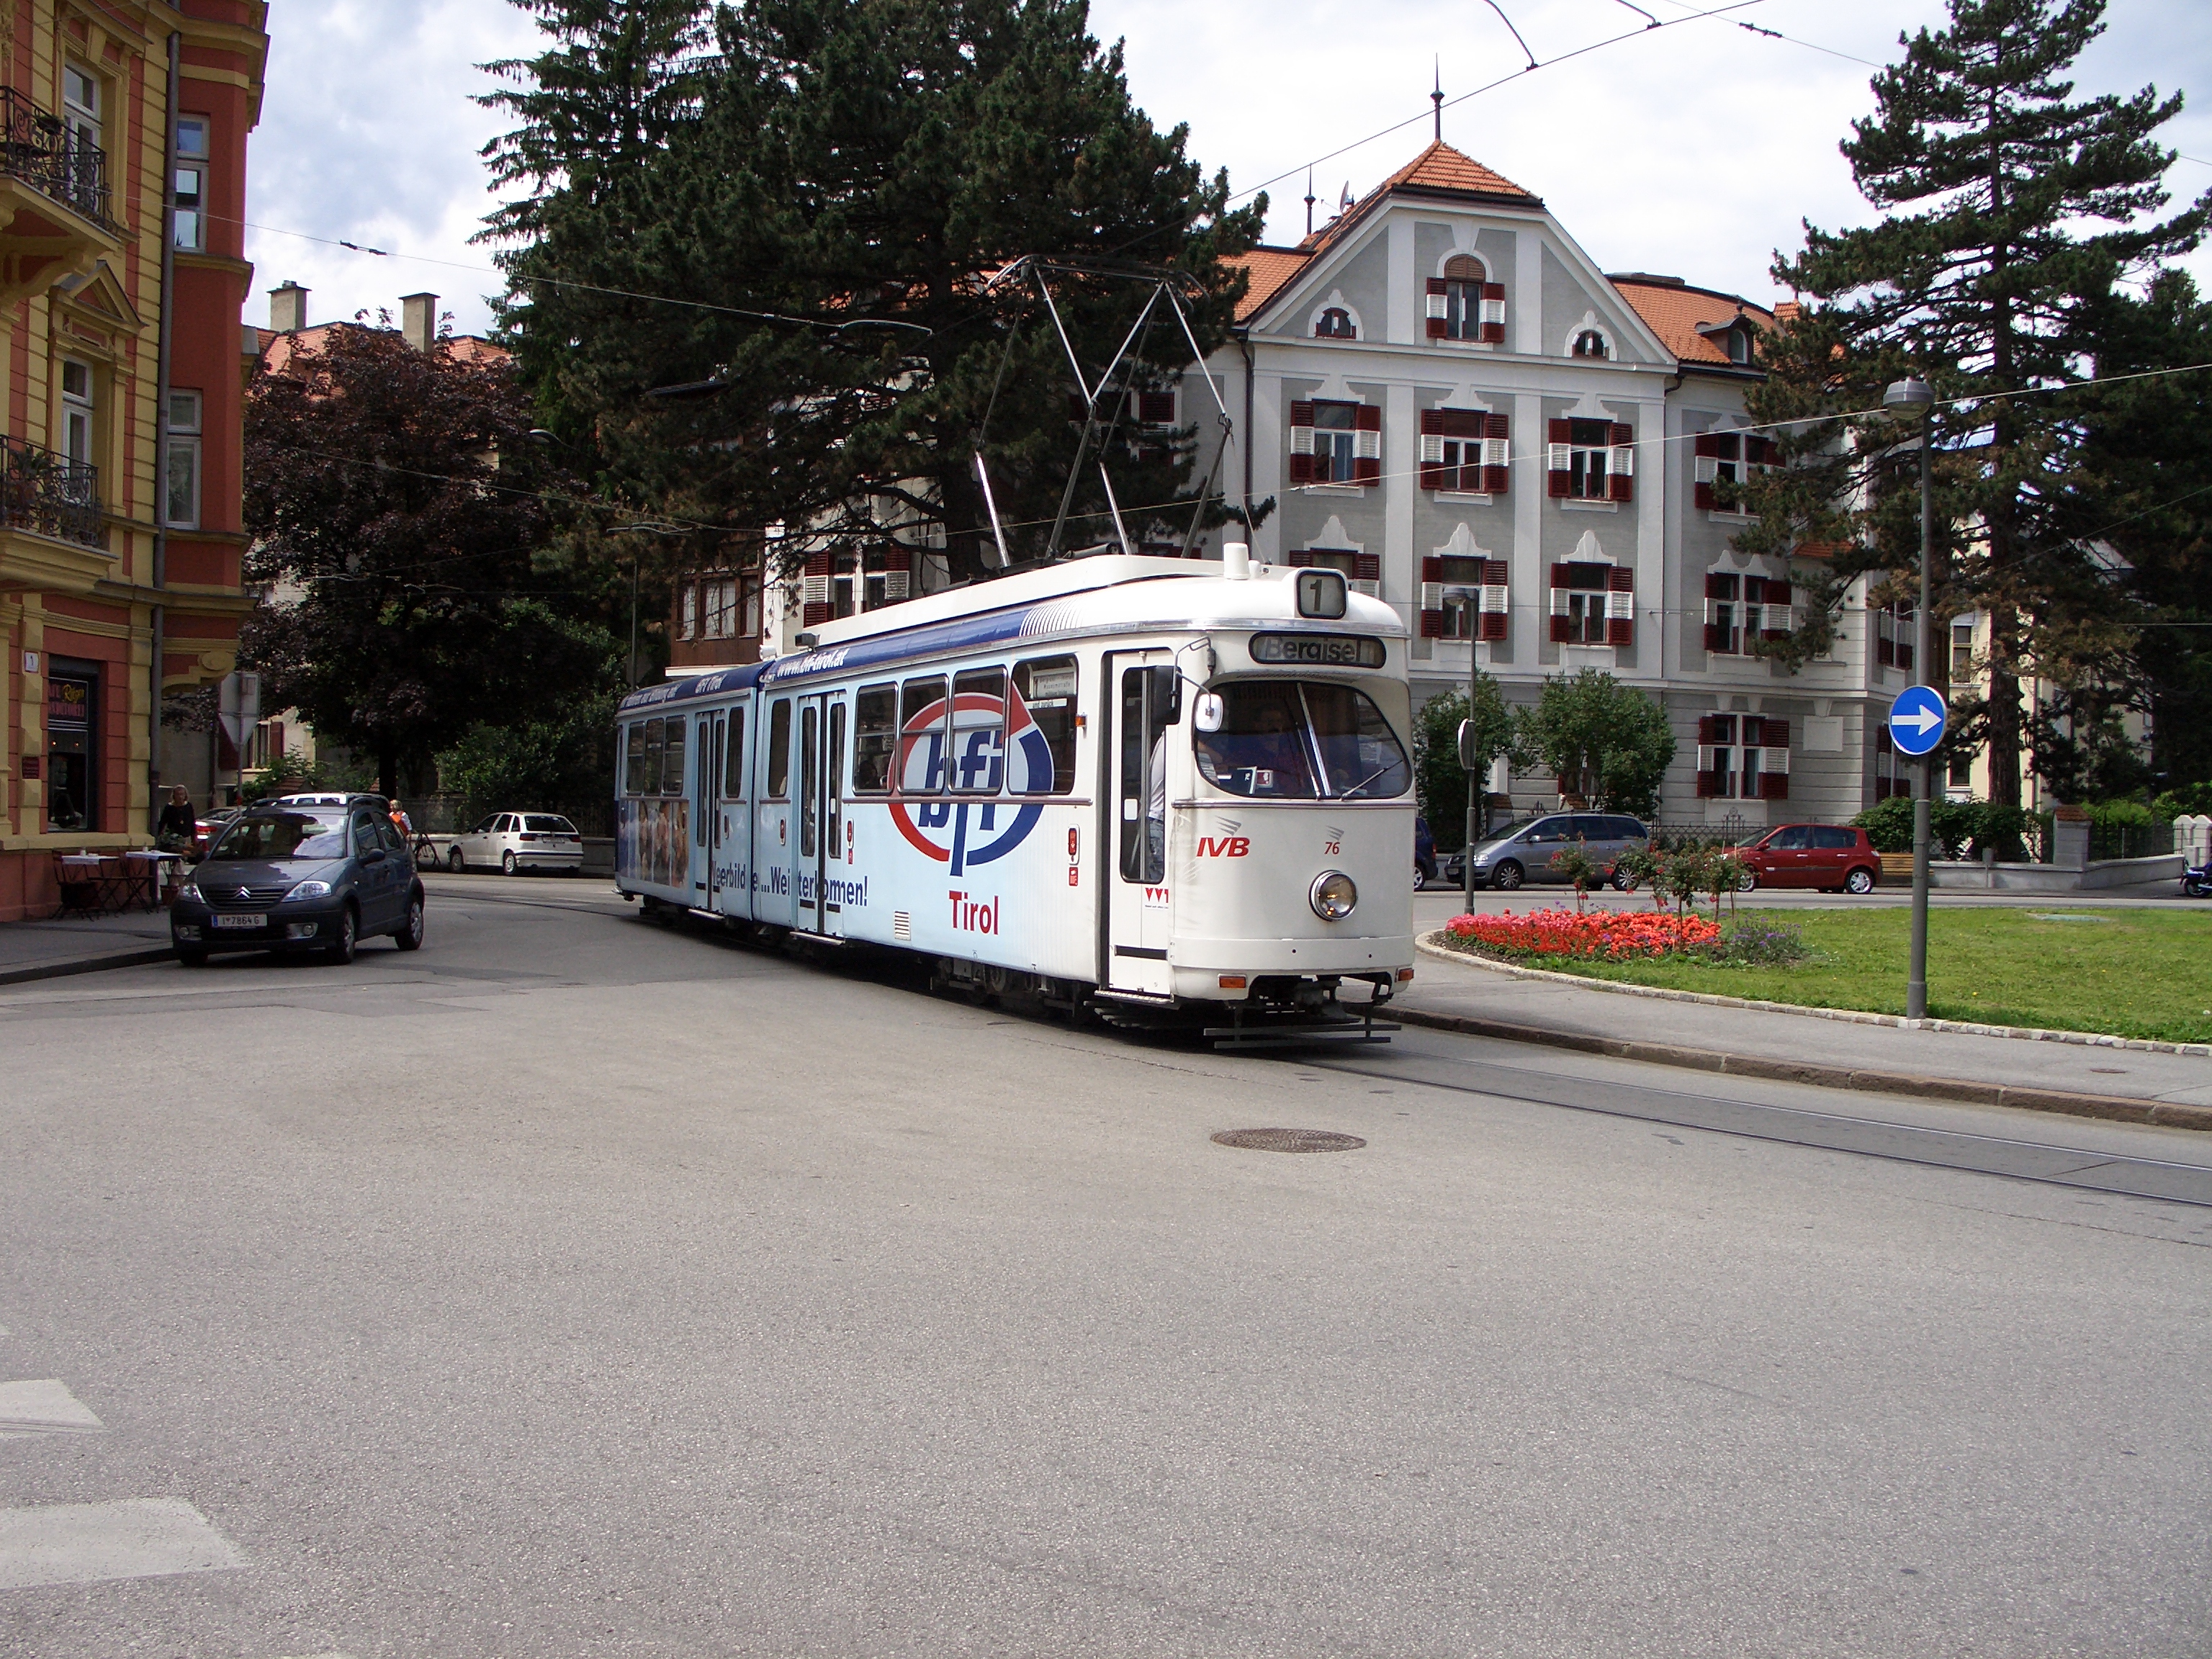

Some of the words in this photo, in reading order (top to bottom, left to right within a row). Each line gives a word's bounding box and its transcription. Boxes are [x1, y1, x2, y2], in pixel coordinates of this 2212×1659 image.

[1310, 579, 1323, 611] 1
[30, 655, 35, 666] 1
[1266, 636, 1362, 662] Bergisel
[918, 729, 1003, 877] bfi
[1196, 837, 1251, 857] IVB
[1324, 841, 1341, 855] 76
[948, 889, 999, 935] Tirol
